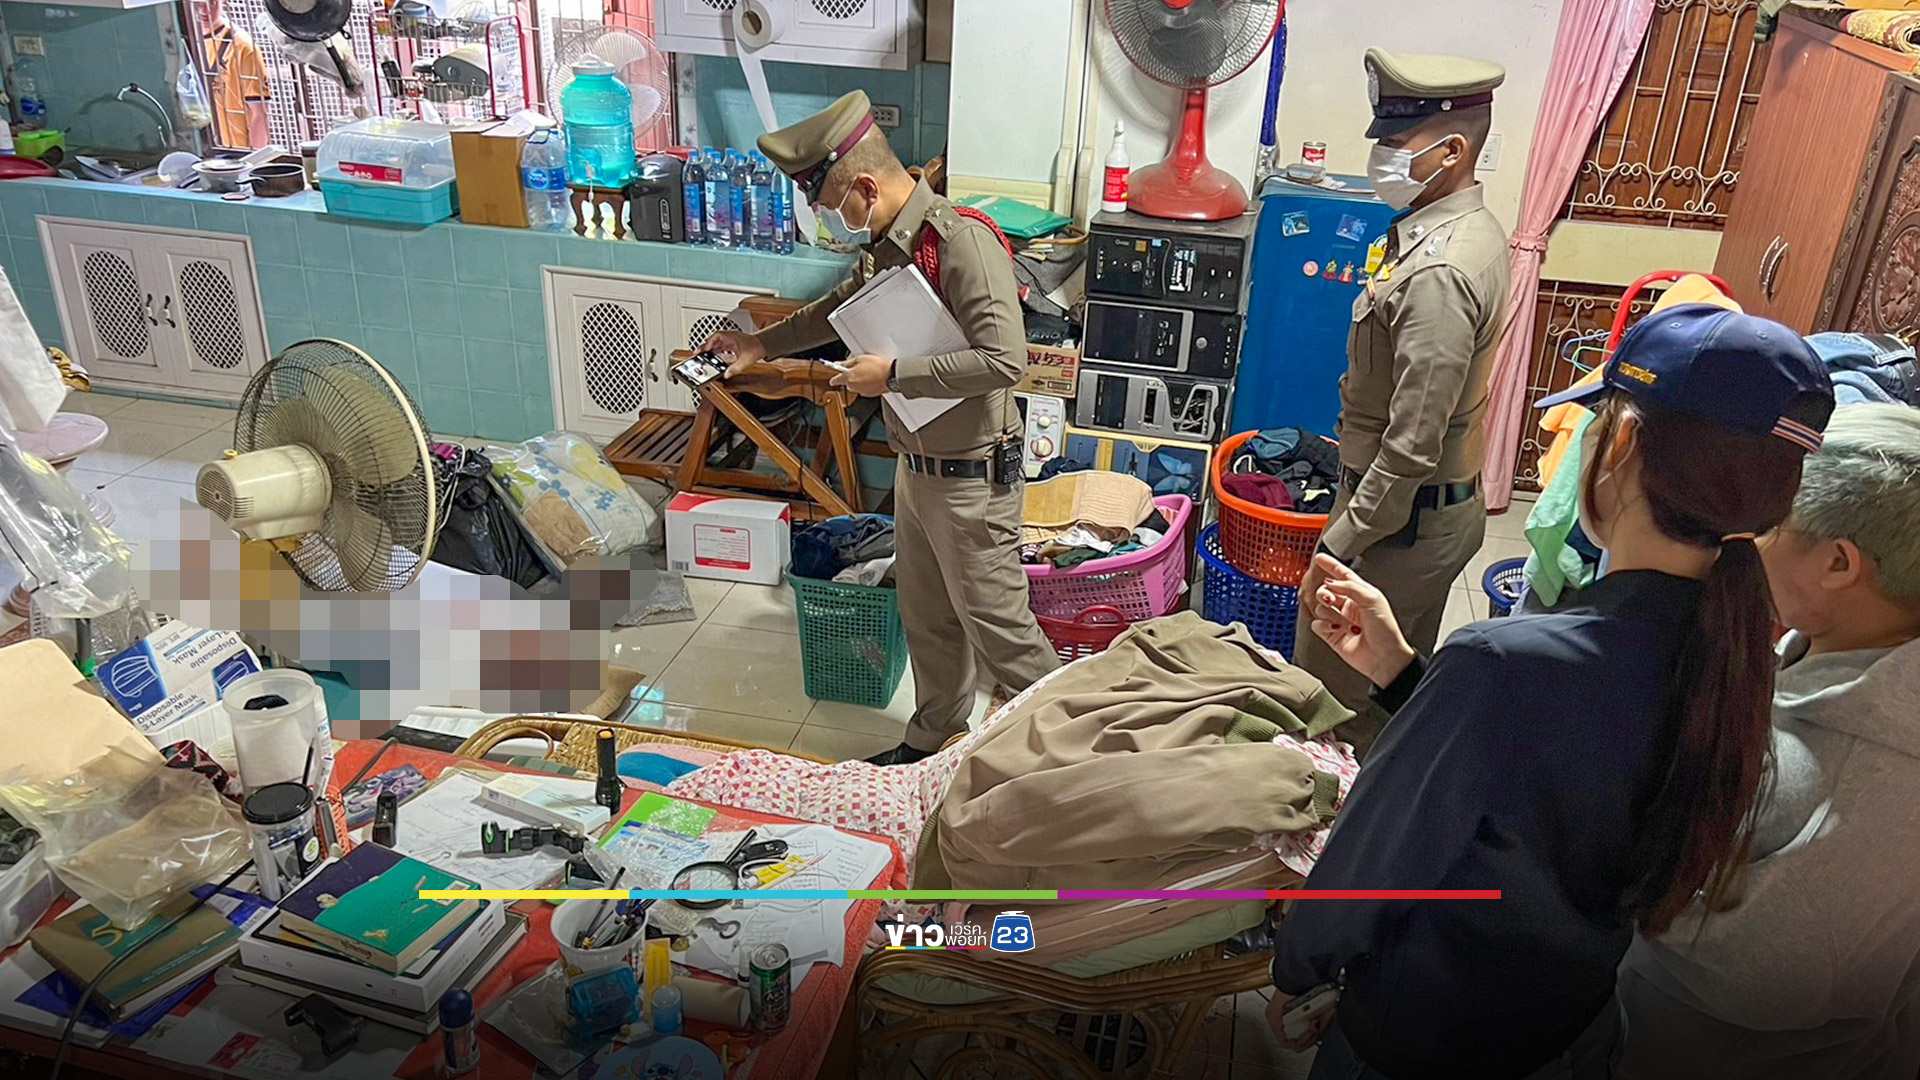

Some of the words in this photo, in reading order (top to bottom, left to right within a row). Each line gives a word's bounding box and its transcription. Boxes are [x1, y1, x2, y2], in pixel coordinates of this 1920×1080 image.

[172, 647, 199, 666] Mask
[190, 636, 238, 669] Disposable
[136, 691, 185, 725] Disposable
[142, 708, 175, 732] 3-Layer
[175, 694, 199, 712] Mask
